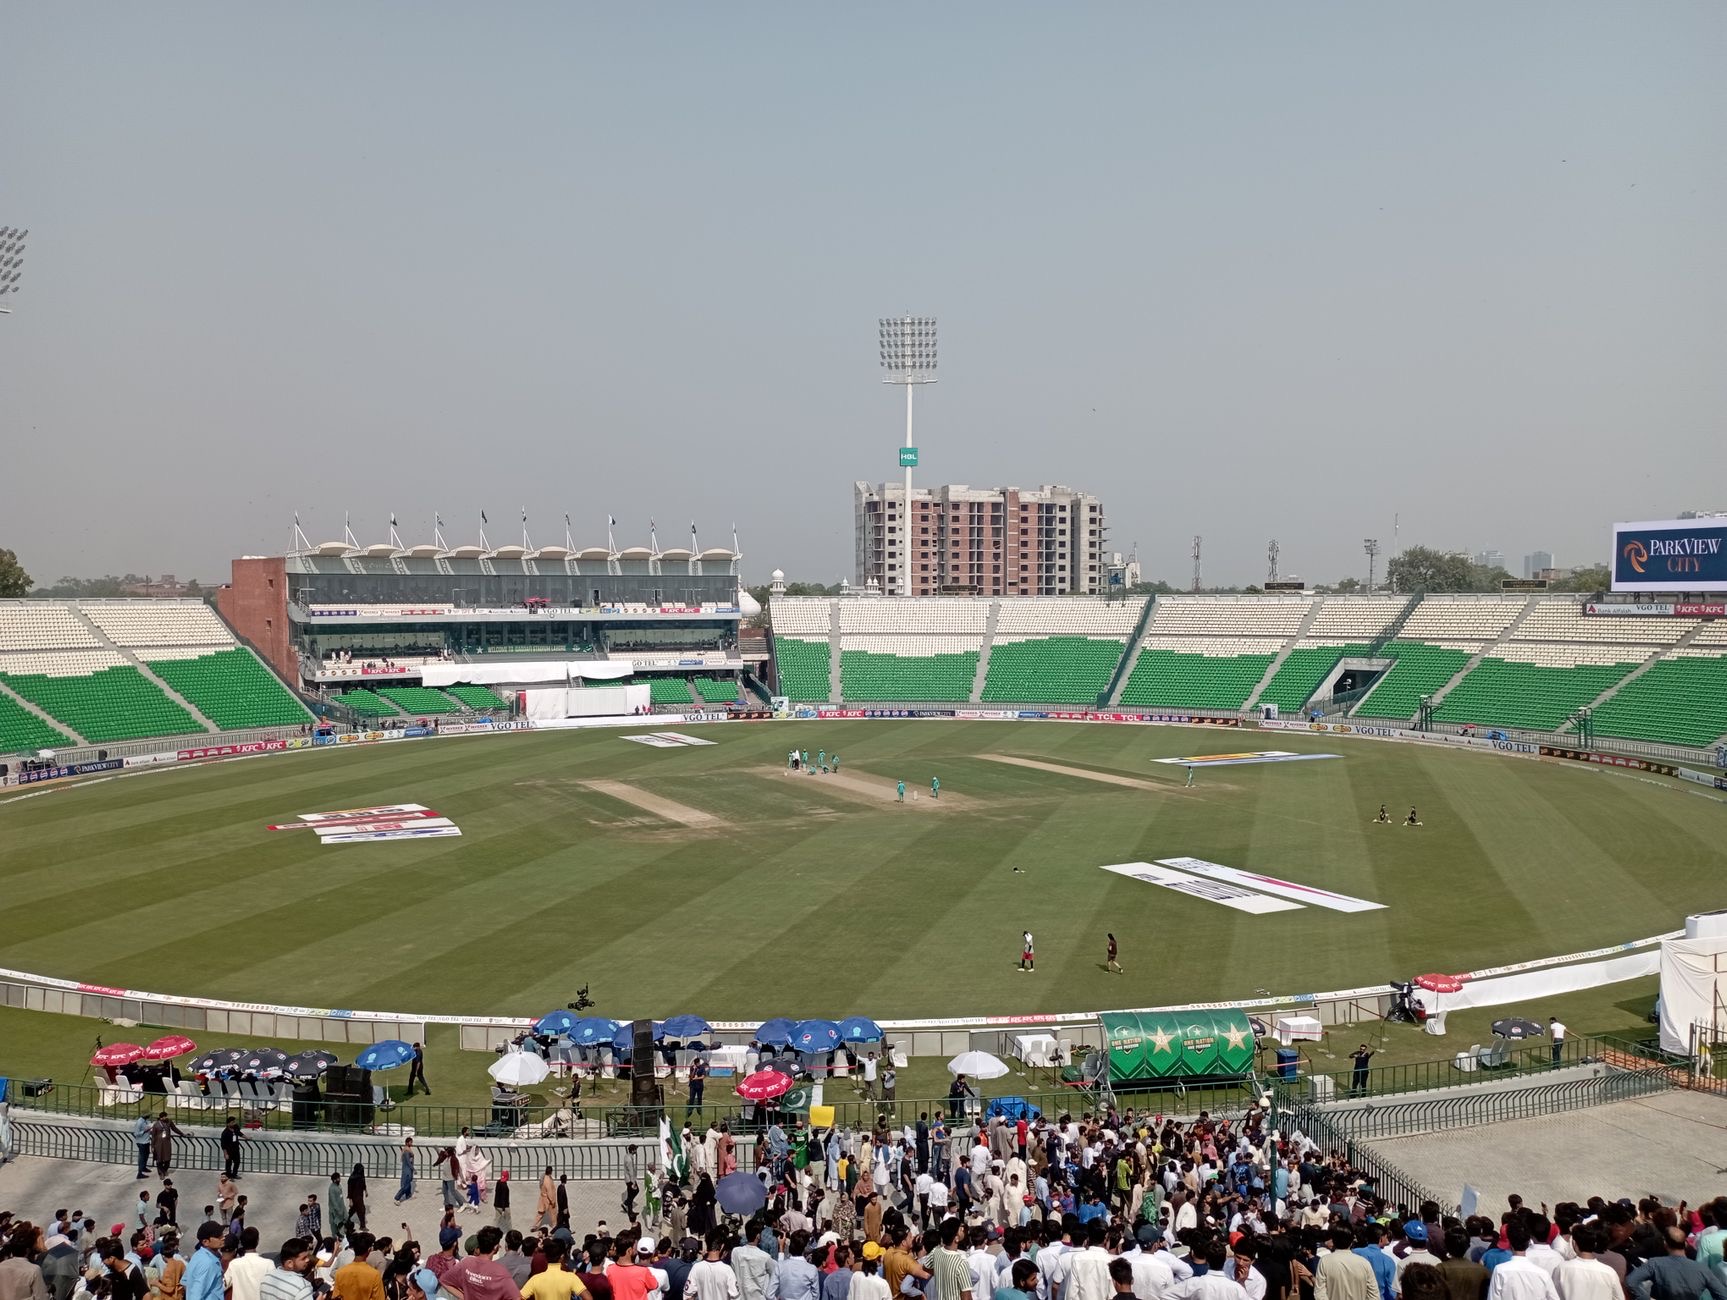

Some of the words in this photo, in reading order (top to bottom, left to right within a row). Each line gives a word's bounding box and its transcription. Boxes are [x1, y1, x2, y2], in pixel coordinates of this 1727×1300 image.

[1649, 538, 1722, 556] PARKVIEW
[1667, 556, 1701, 573] CITY
[683, 713, 703, 721] VGO
[491, 721, 512, 730] VGO
[513, 721, 532, 730] TEL
[1355, 725, 1374, 735] VGO
[1376, 727, 1394, 737] TEL
[242, 744, 259, 753] KFC
[266, 742, 283, 750] KFC
[1492, 740, 1513, 751] VGO
[1515, 743, 1535, 753] TEL
[163, 1045, 177, 1053] KFC
[766, 1083, 780, 1092] KFC
